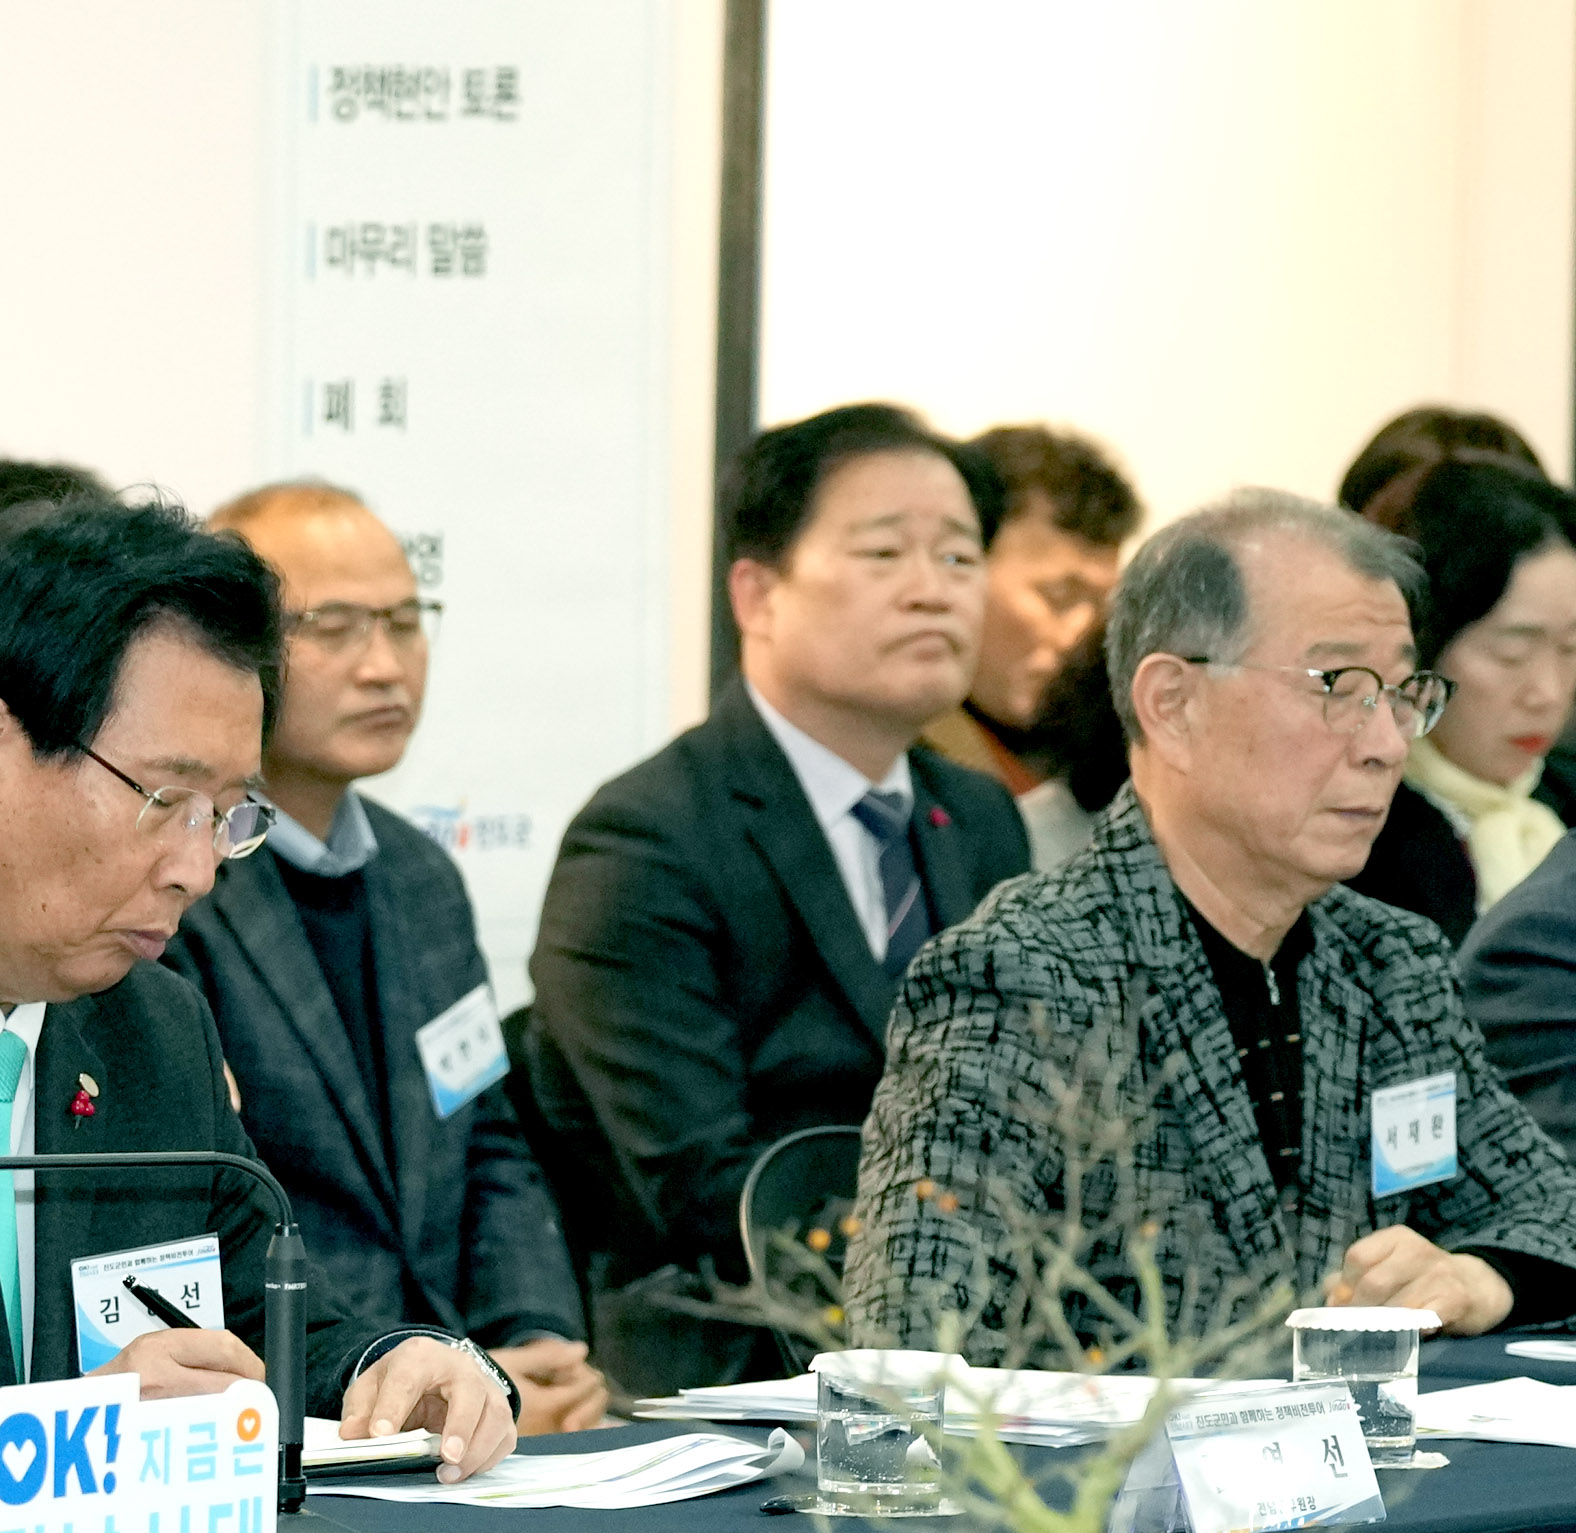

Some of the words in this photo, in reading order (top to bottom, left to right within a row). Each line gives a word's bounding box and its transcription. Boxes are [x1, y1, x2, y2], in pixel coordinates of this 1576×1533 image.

[462, 64, 521, 120] 토론
[325, 221, 417, 276] 마무리
[427, 221, 488, 275] 말씀
[139, 1407, 265, 1485] 지금은
